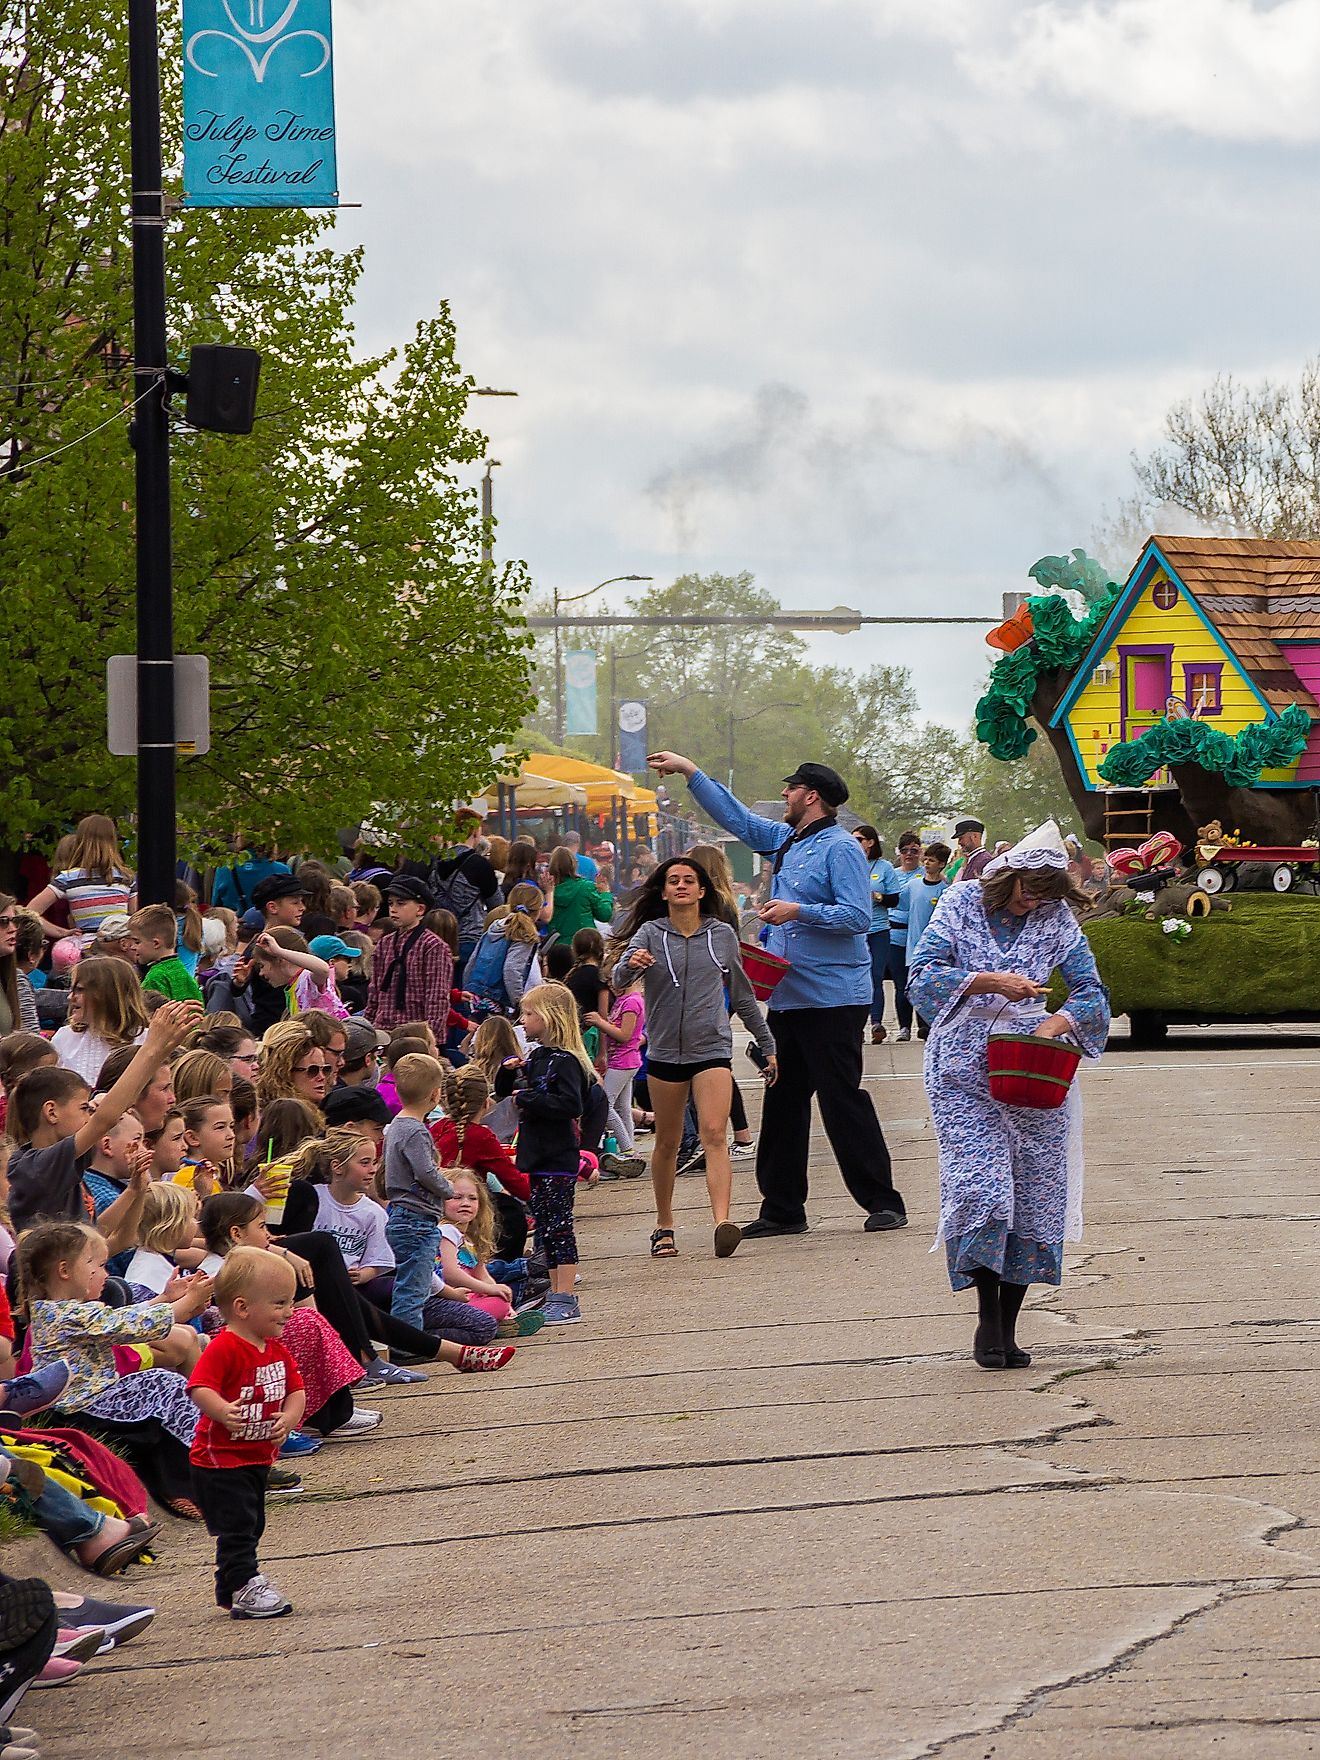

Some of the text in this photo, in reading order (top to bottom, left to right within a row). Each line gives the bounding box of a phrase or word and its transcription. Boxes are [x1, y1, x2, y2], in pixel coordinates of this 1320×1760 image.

[186, 110, 335, 153] Tulip Time
[206, 153, 324, 184] Festival
